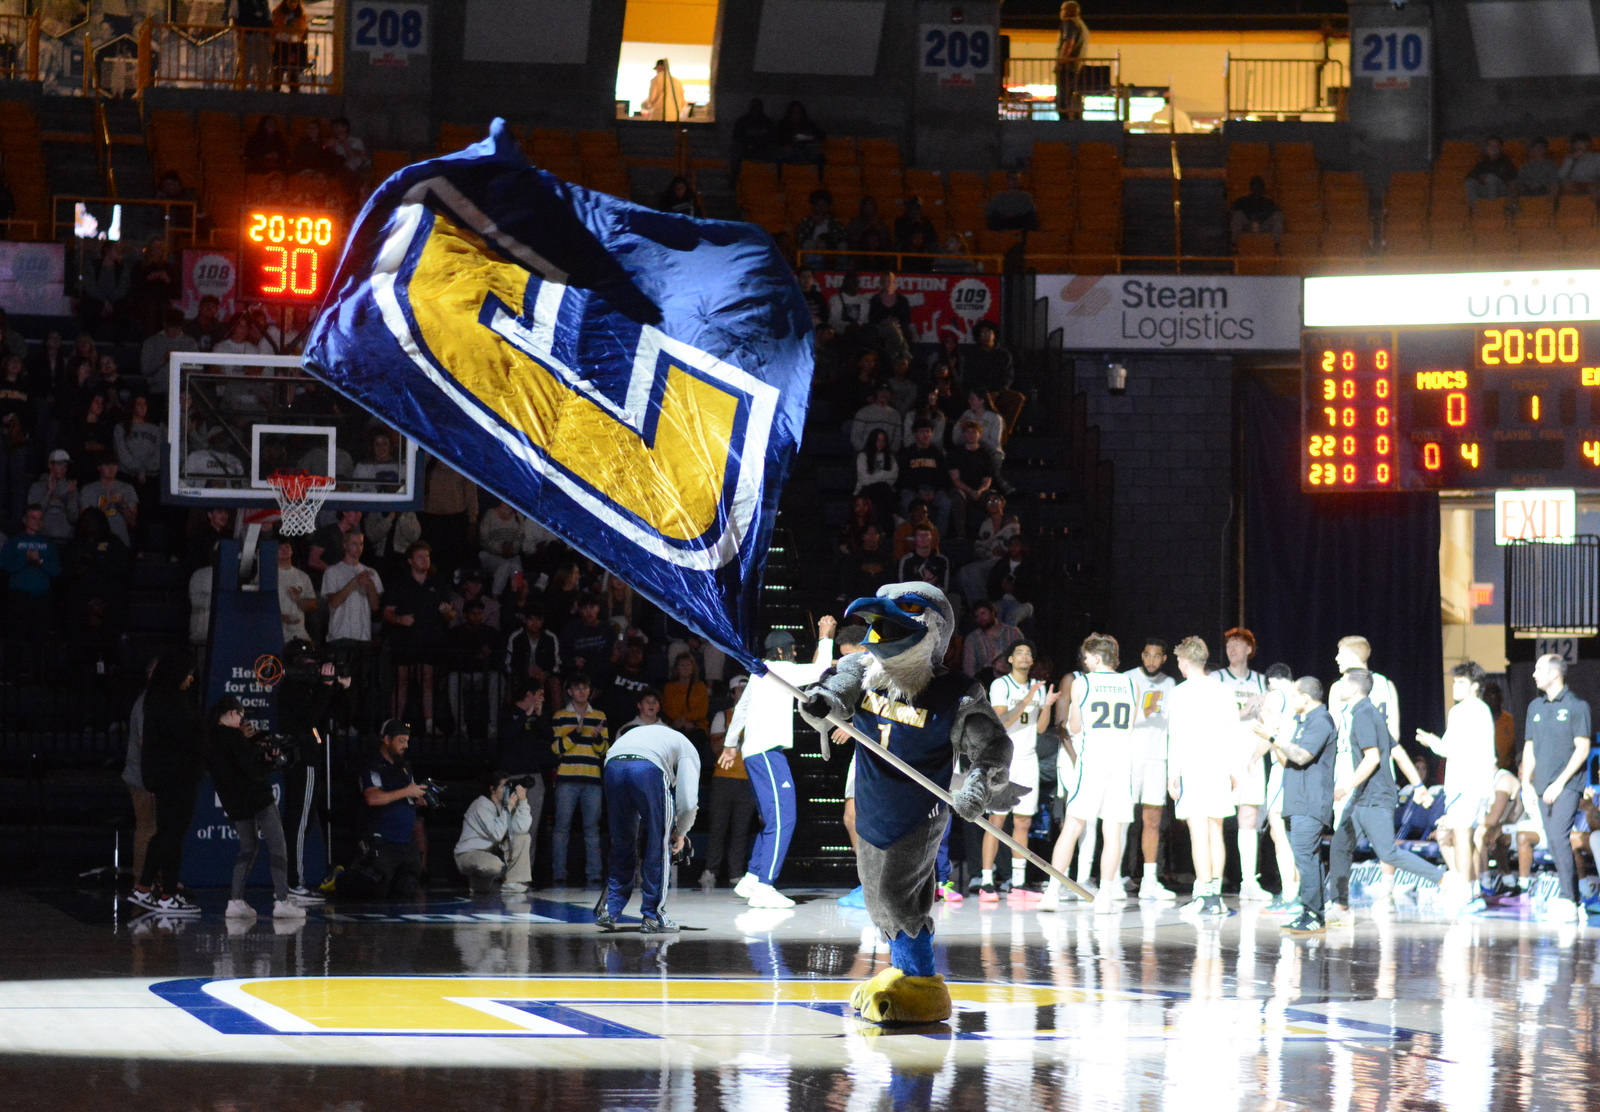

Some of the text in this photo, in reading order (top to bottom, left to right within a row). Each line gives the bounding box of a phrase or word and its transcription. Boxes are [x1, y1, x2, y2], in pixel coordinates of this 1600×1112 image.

[357, 7, 422, 48] 208
[925, 29, 989, 68] 209
[1362, 33, 1422, 71] 210
[249, 213, 332, 246] 20:00
[263, 245, 318, 295] 30
[955, 288, 986, 303] 109
[1122, 279, 1227, 308] Steam
[1468, 290, 1590, 318] unum
[1121, 311, 1254, 347] Logistics
[1482, 327, 1579, 365] 20:00
[1376, 350, 1389, 370] 0
[1376, 378, 1389, 398] 0
[1416, 370, 1468, 390] MOCS
[1376, 406, 1389, 427] 0
[1446, 392, 1466, 426] 0
[1531, 394, 1540, 421] 1
[1376, 434, 1389, 455] 0
[1424, 442, 1441, 470] 0
[1460, 442, 1479, 468] 4
[1583, 441, 1600, 466] 4
[1377, 462, 1390, 483] 0
[1502, 499, 1568, 540] EXIT
[1474, 589, 1491, 605] EXIT
[224, 680, 246, 693] for
[1094, 685, 1127, 695] VITTERS
[1090, 700, 1131, 730] 20
[196, 824, 215, 840] of
